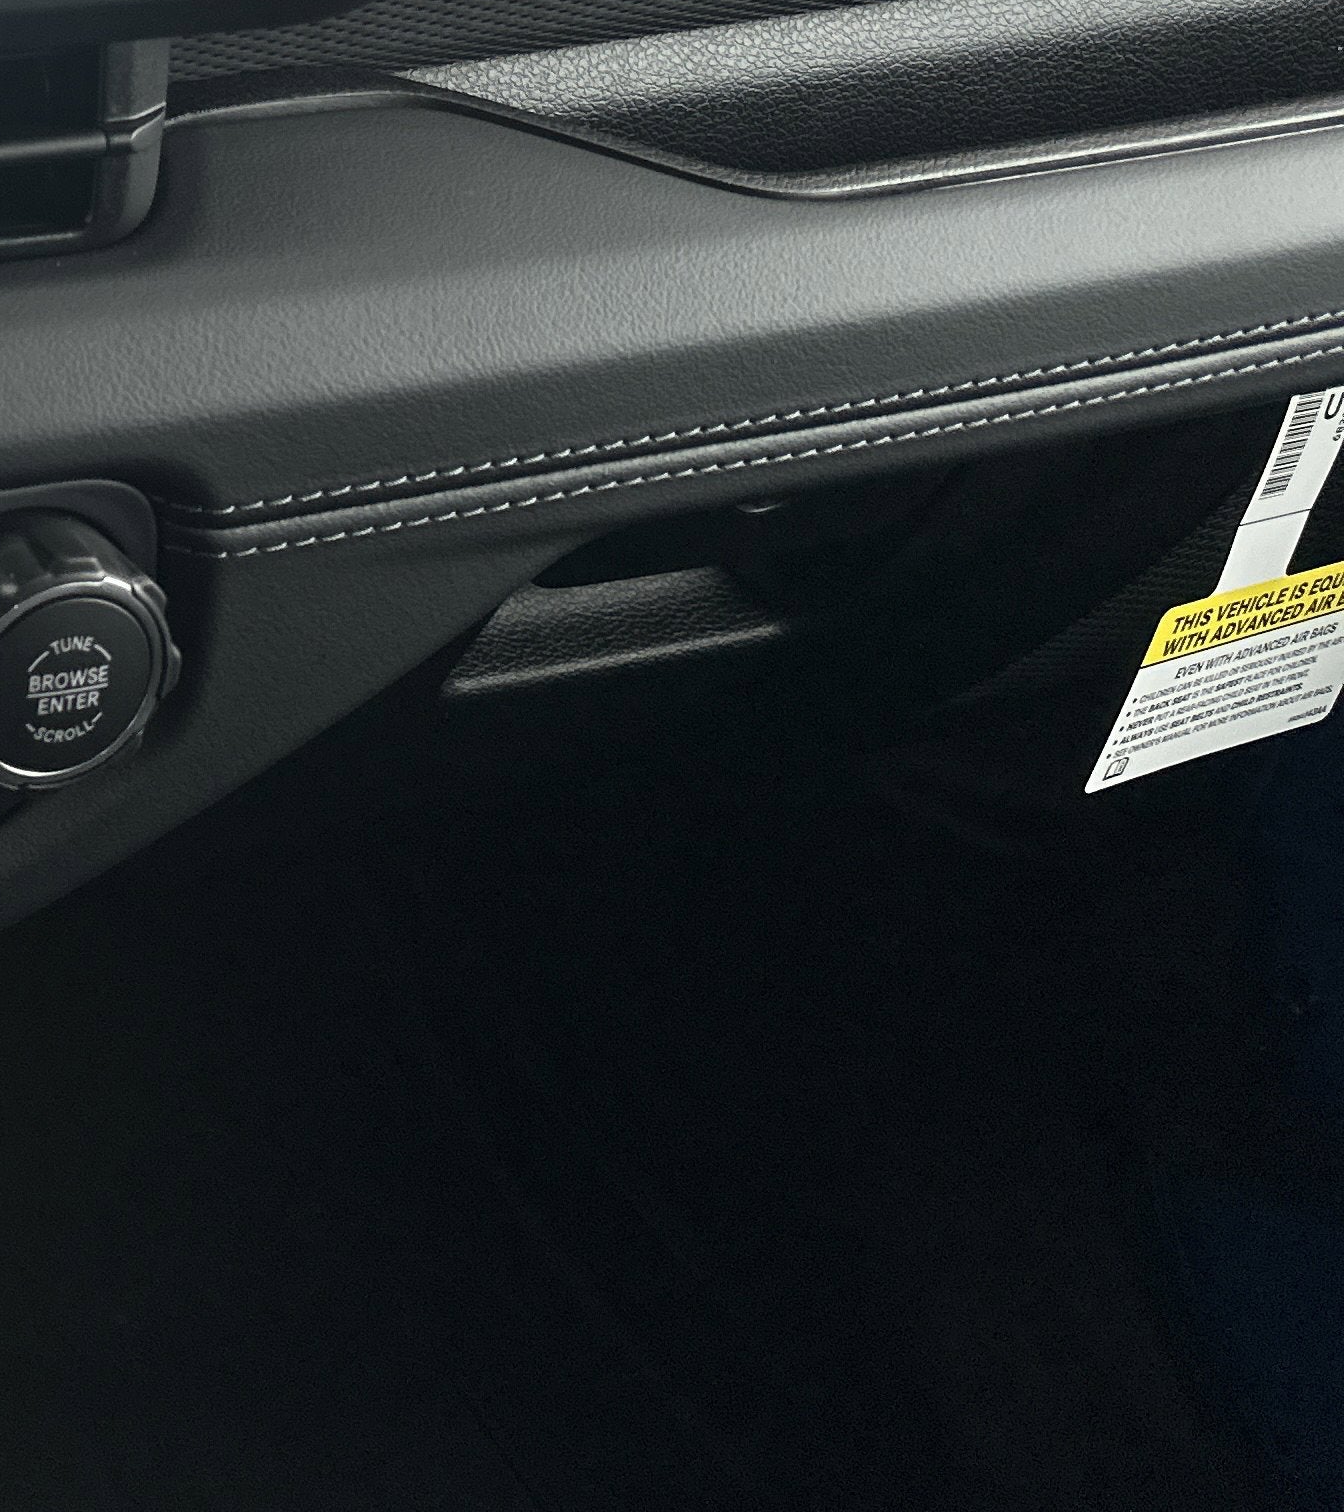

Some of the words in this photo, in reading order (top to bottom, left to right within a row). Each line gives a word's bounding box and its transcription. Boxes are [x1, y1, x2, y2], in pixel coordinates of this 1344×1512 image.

[1172, 608, 1214, 634] THIS
[1216, 586, 1290, 621] VEHICLE
[1288, 582, 1309, 601] IS
[1163, 628, 1210, 657] WITH
[1209, 602, 1305, 643] ADVANCED
[1303, 593, 1336, 616] AIR
[48, 634, 96, 656] TUNE
[1174, 661, 1202, 679] EVEN
[1204, 652, 1234, 671] WITH
[1231, 635, 1291, 662] ADVANCED
[27, 664, 110, 693] BROWSE
[35, 690, 100, 716] ENTER
[30, 719, 96, 744] SCROLL
